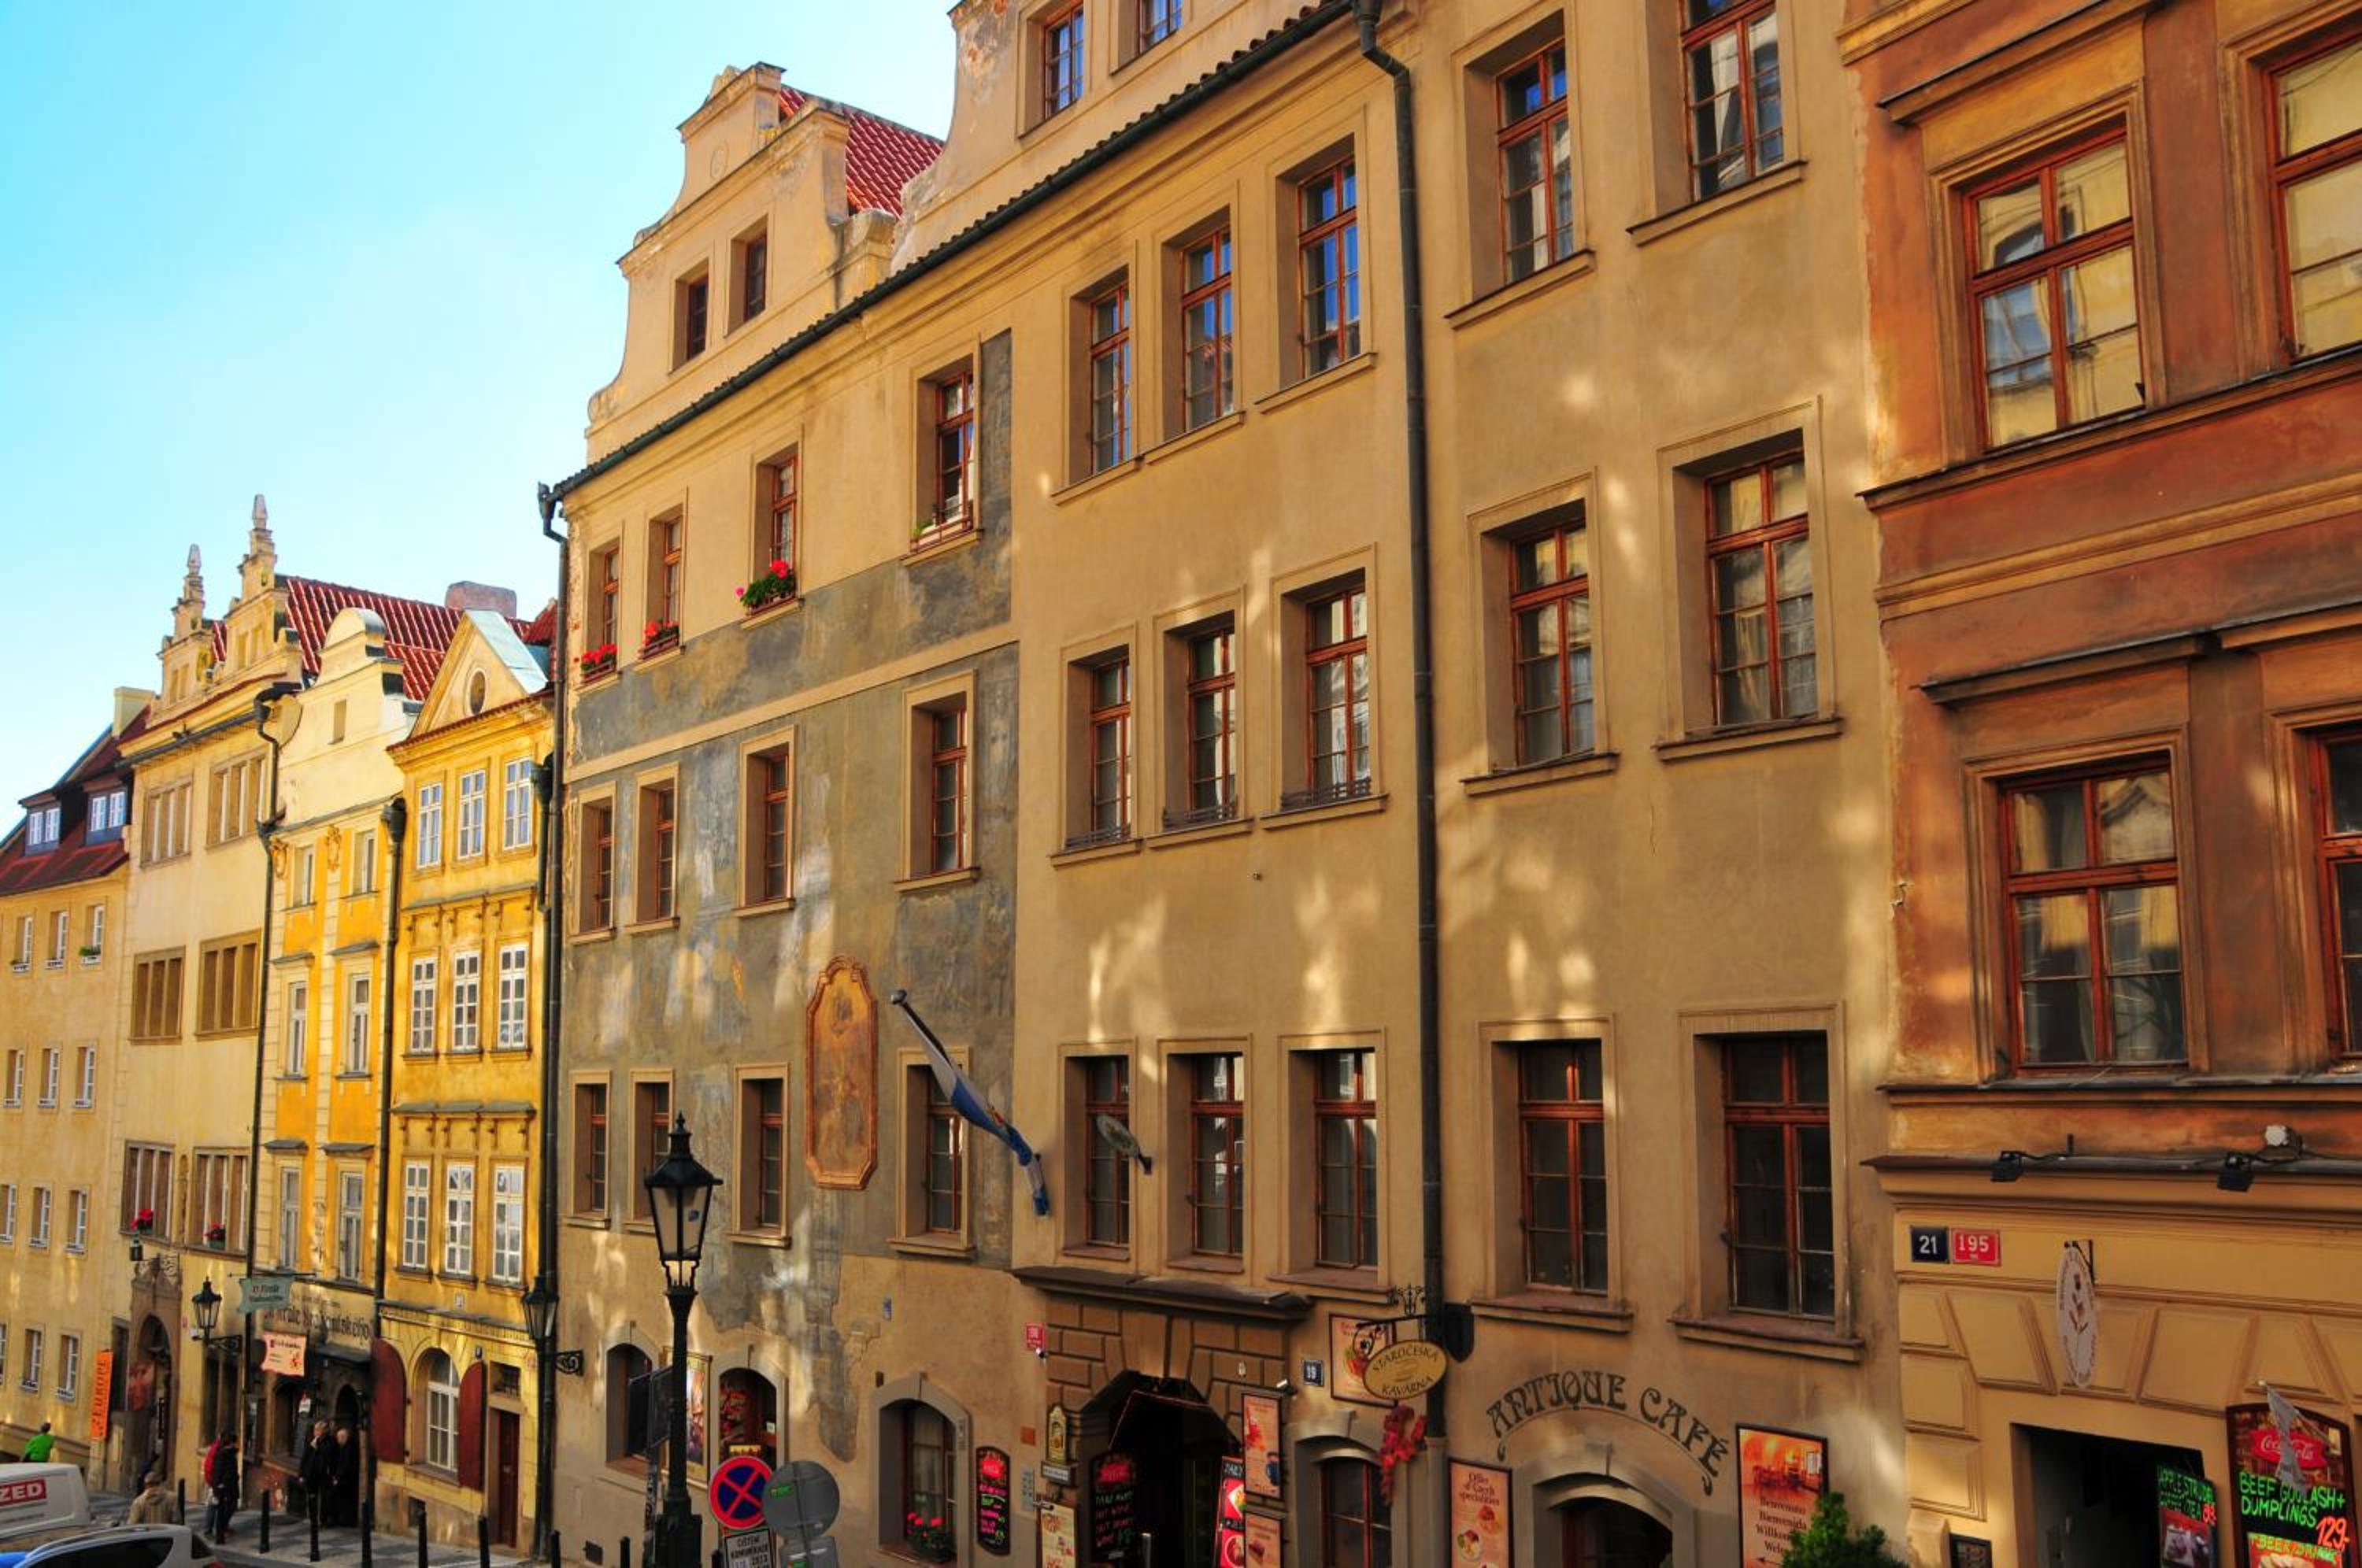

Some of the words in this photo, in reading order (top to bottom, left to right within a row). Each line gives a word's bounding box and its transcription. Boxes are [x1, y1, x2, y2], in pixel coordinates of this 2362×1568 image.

[1919, 1235, 1937, 1255] 21
[1958, 1233, 1990, 1253] 195
[1486, 1370, 1627, 1439] ANTIQUE
[1639, 1386, 1731, 1478] CAFÉ
[2239, 1471, 2277, 1497] BEEF
[2242, 1496, 2319, 1529] DUMPLINGS
